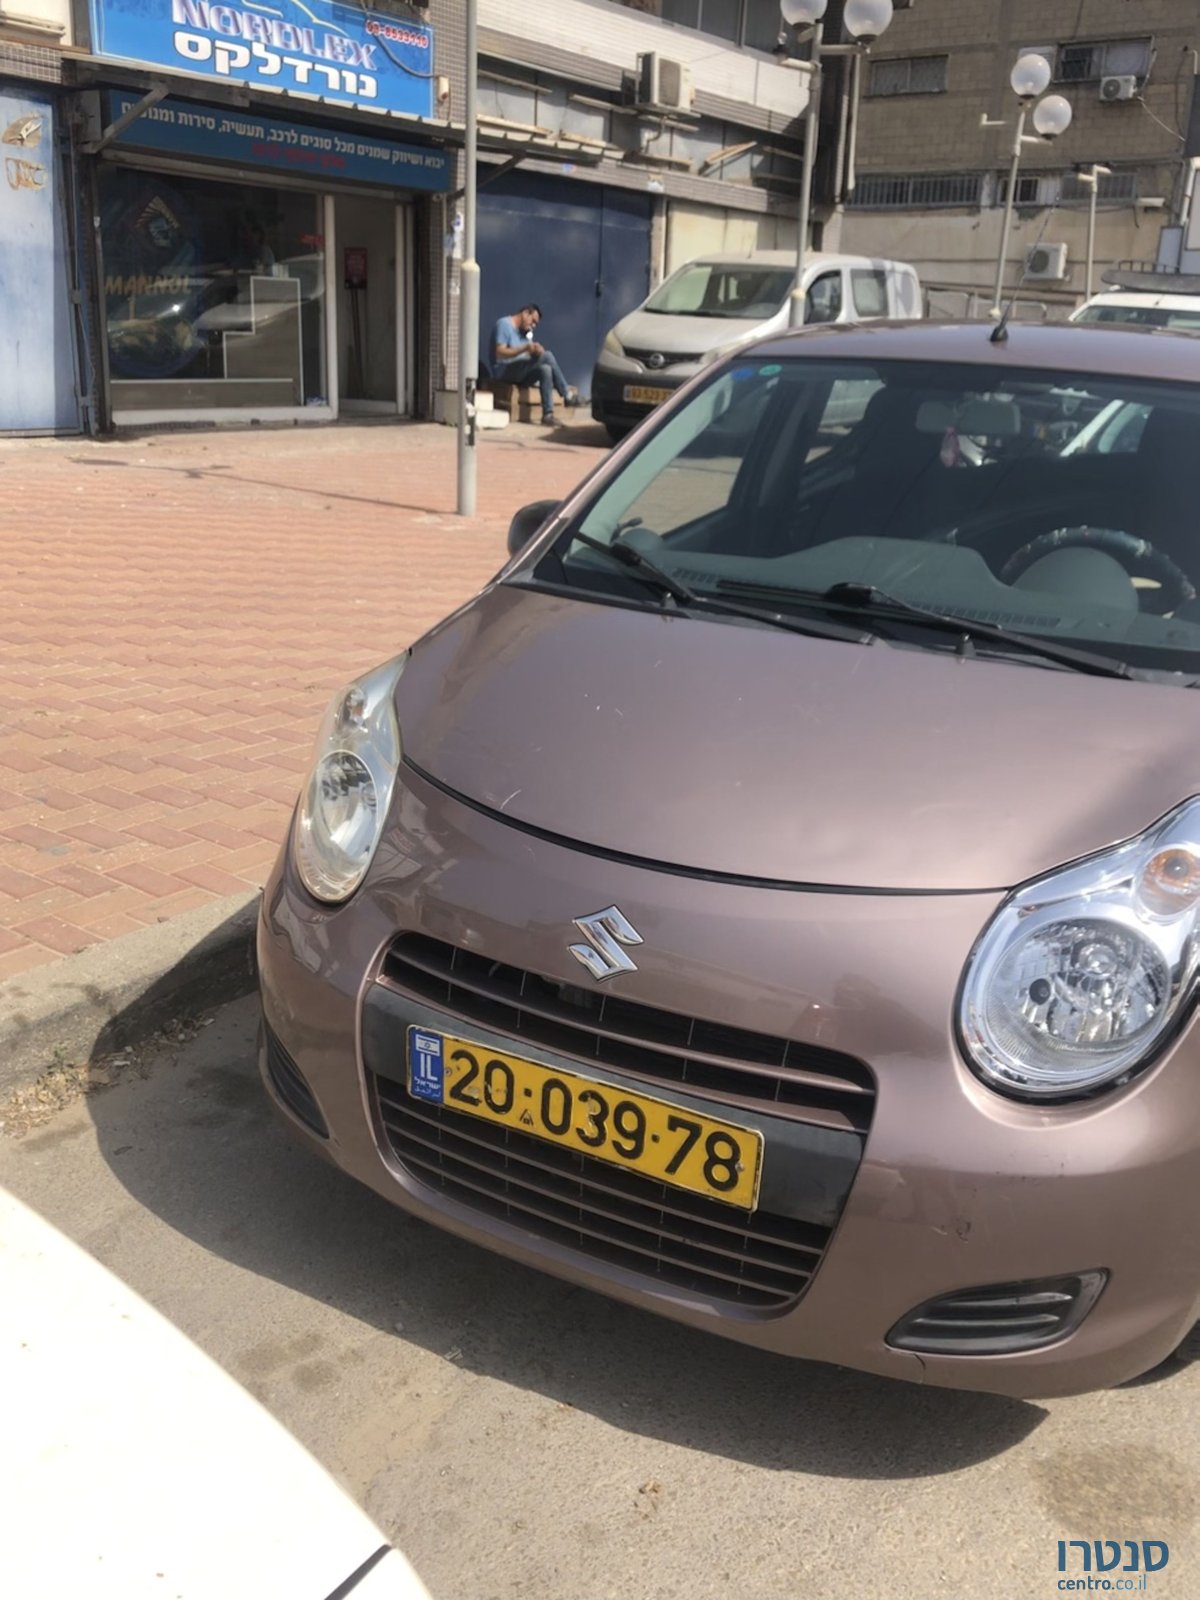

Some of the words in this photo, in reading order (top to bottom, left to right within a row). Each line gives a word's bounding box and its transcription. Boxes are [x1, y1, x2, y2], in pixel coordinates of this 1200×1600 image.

[172, 0, 378, 71] NORDLEX
[173, 31, 378, 99] נורדלקס
[177, 111, 216, 130] סירות
[219, 119, 264, 139] תעשיה,
[266, 124, 298, 144] לרכב,
[300, 133, 332, 150] סוגים
[334, 136, 355, 154] מכל
[357, 144, 391, 160] שמנים
[420, 1052, 438, 1081] IL
